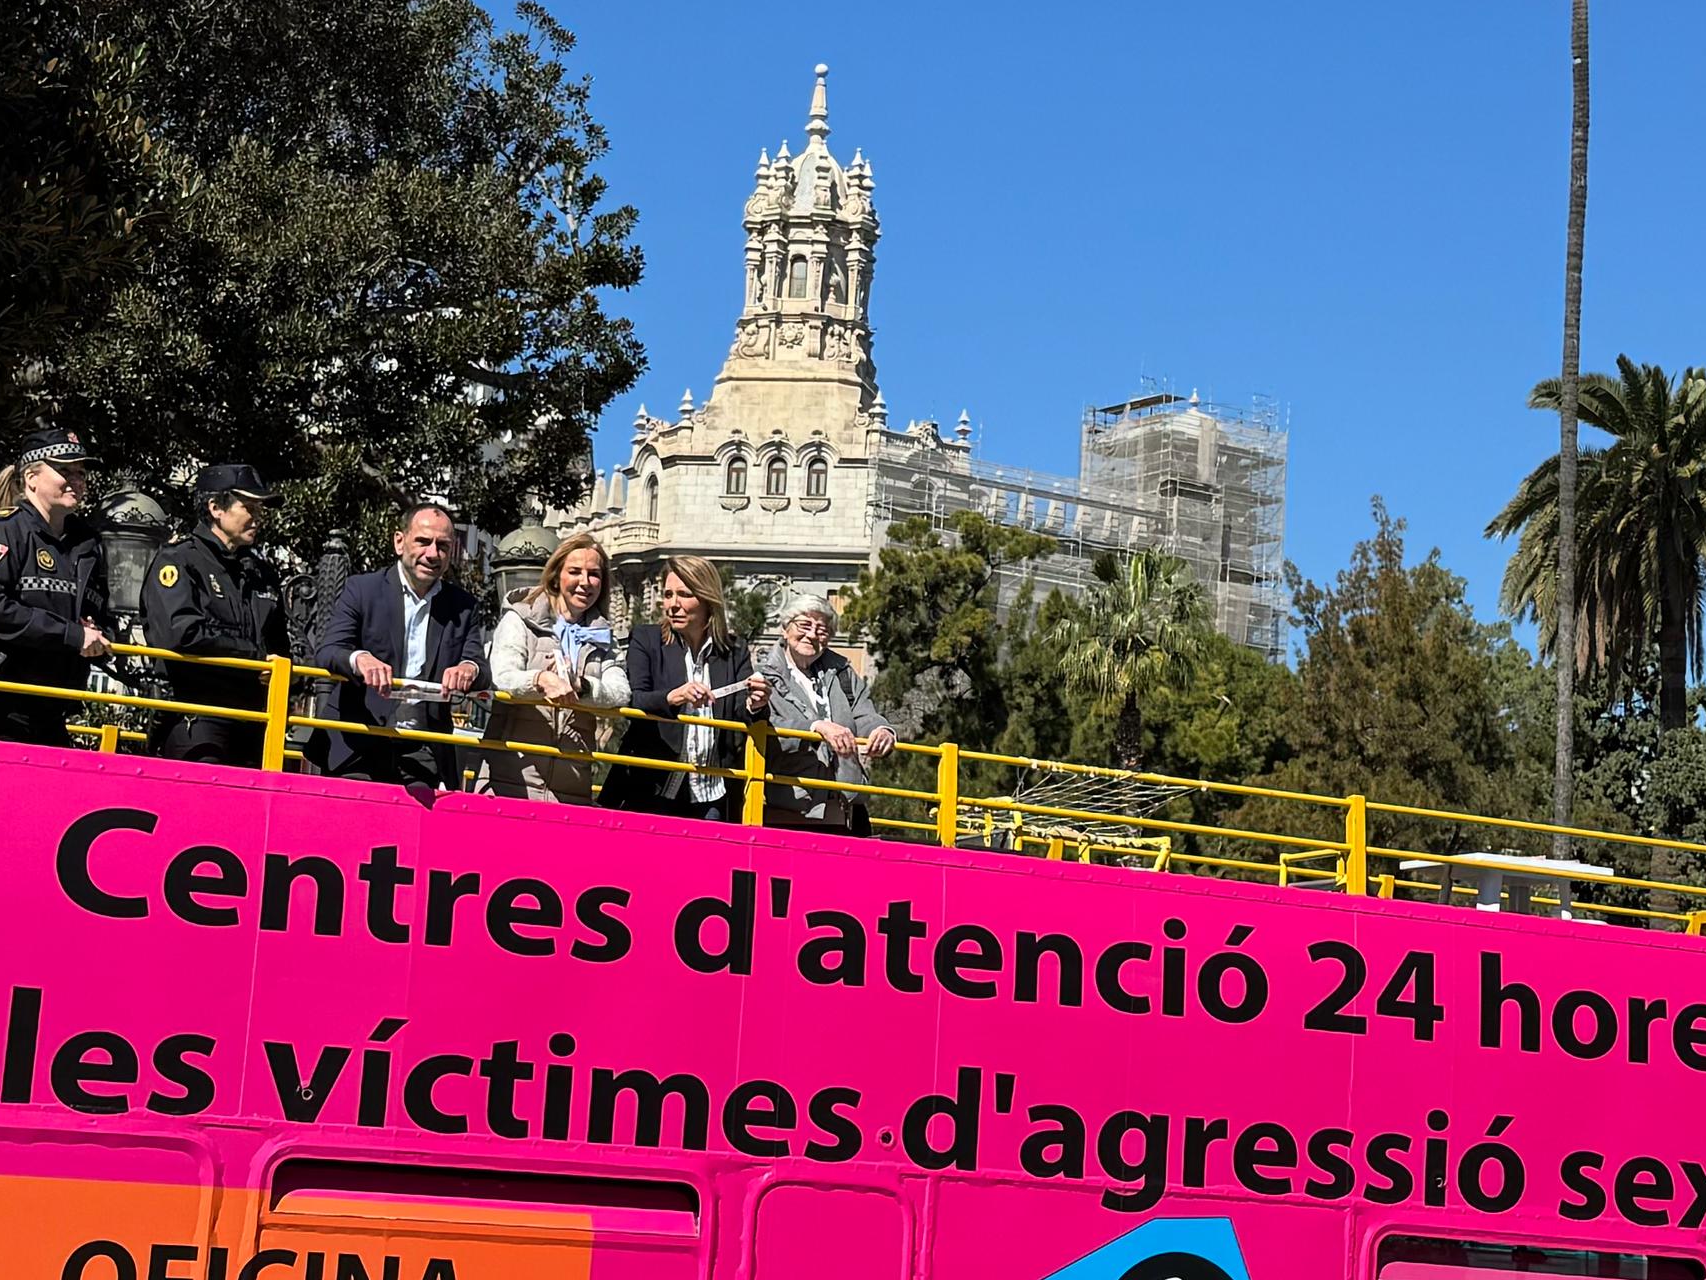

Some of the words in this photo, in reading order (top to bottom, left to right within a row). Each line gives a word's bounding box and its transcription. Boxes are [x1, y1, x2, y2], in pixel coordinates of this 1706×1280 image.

[56, 807, 633, 964] Centres
[672, 869, 1269, 1026] d'atenció
[1304, 941, 1445, 1042] 24
[0, 986, 218, 1116] les
[262, 1017, 863, 1163] víctimes
[901, 1066, 1526, 1214] d'agressió
